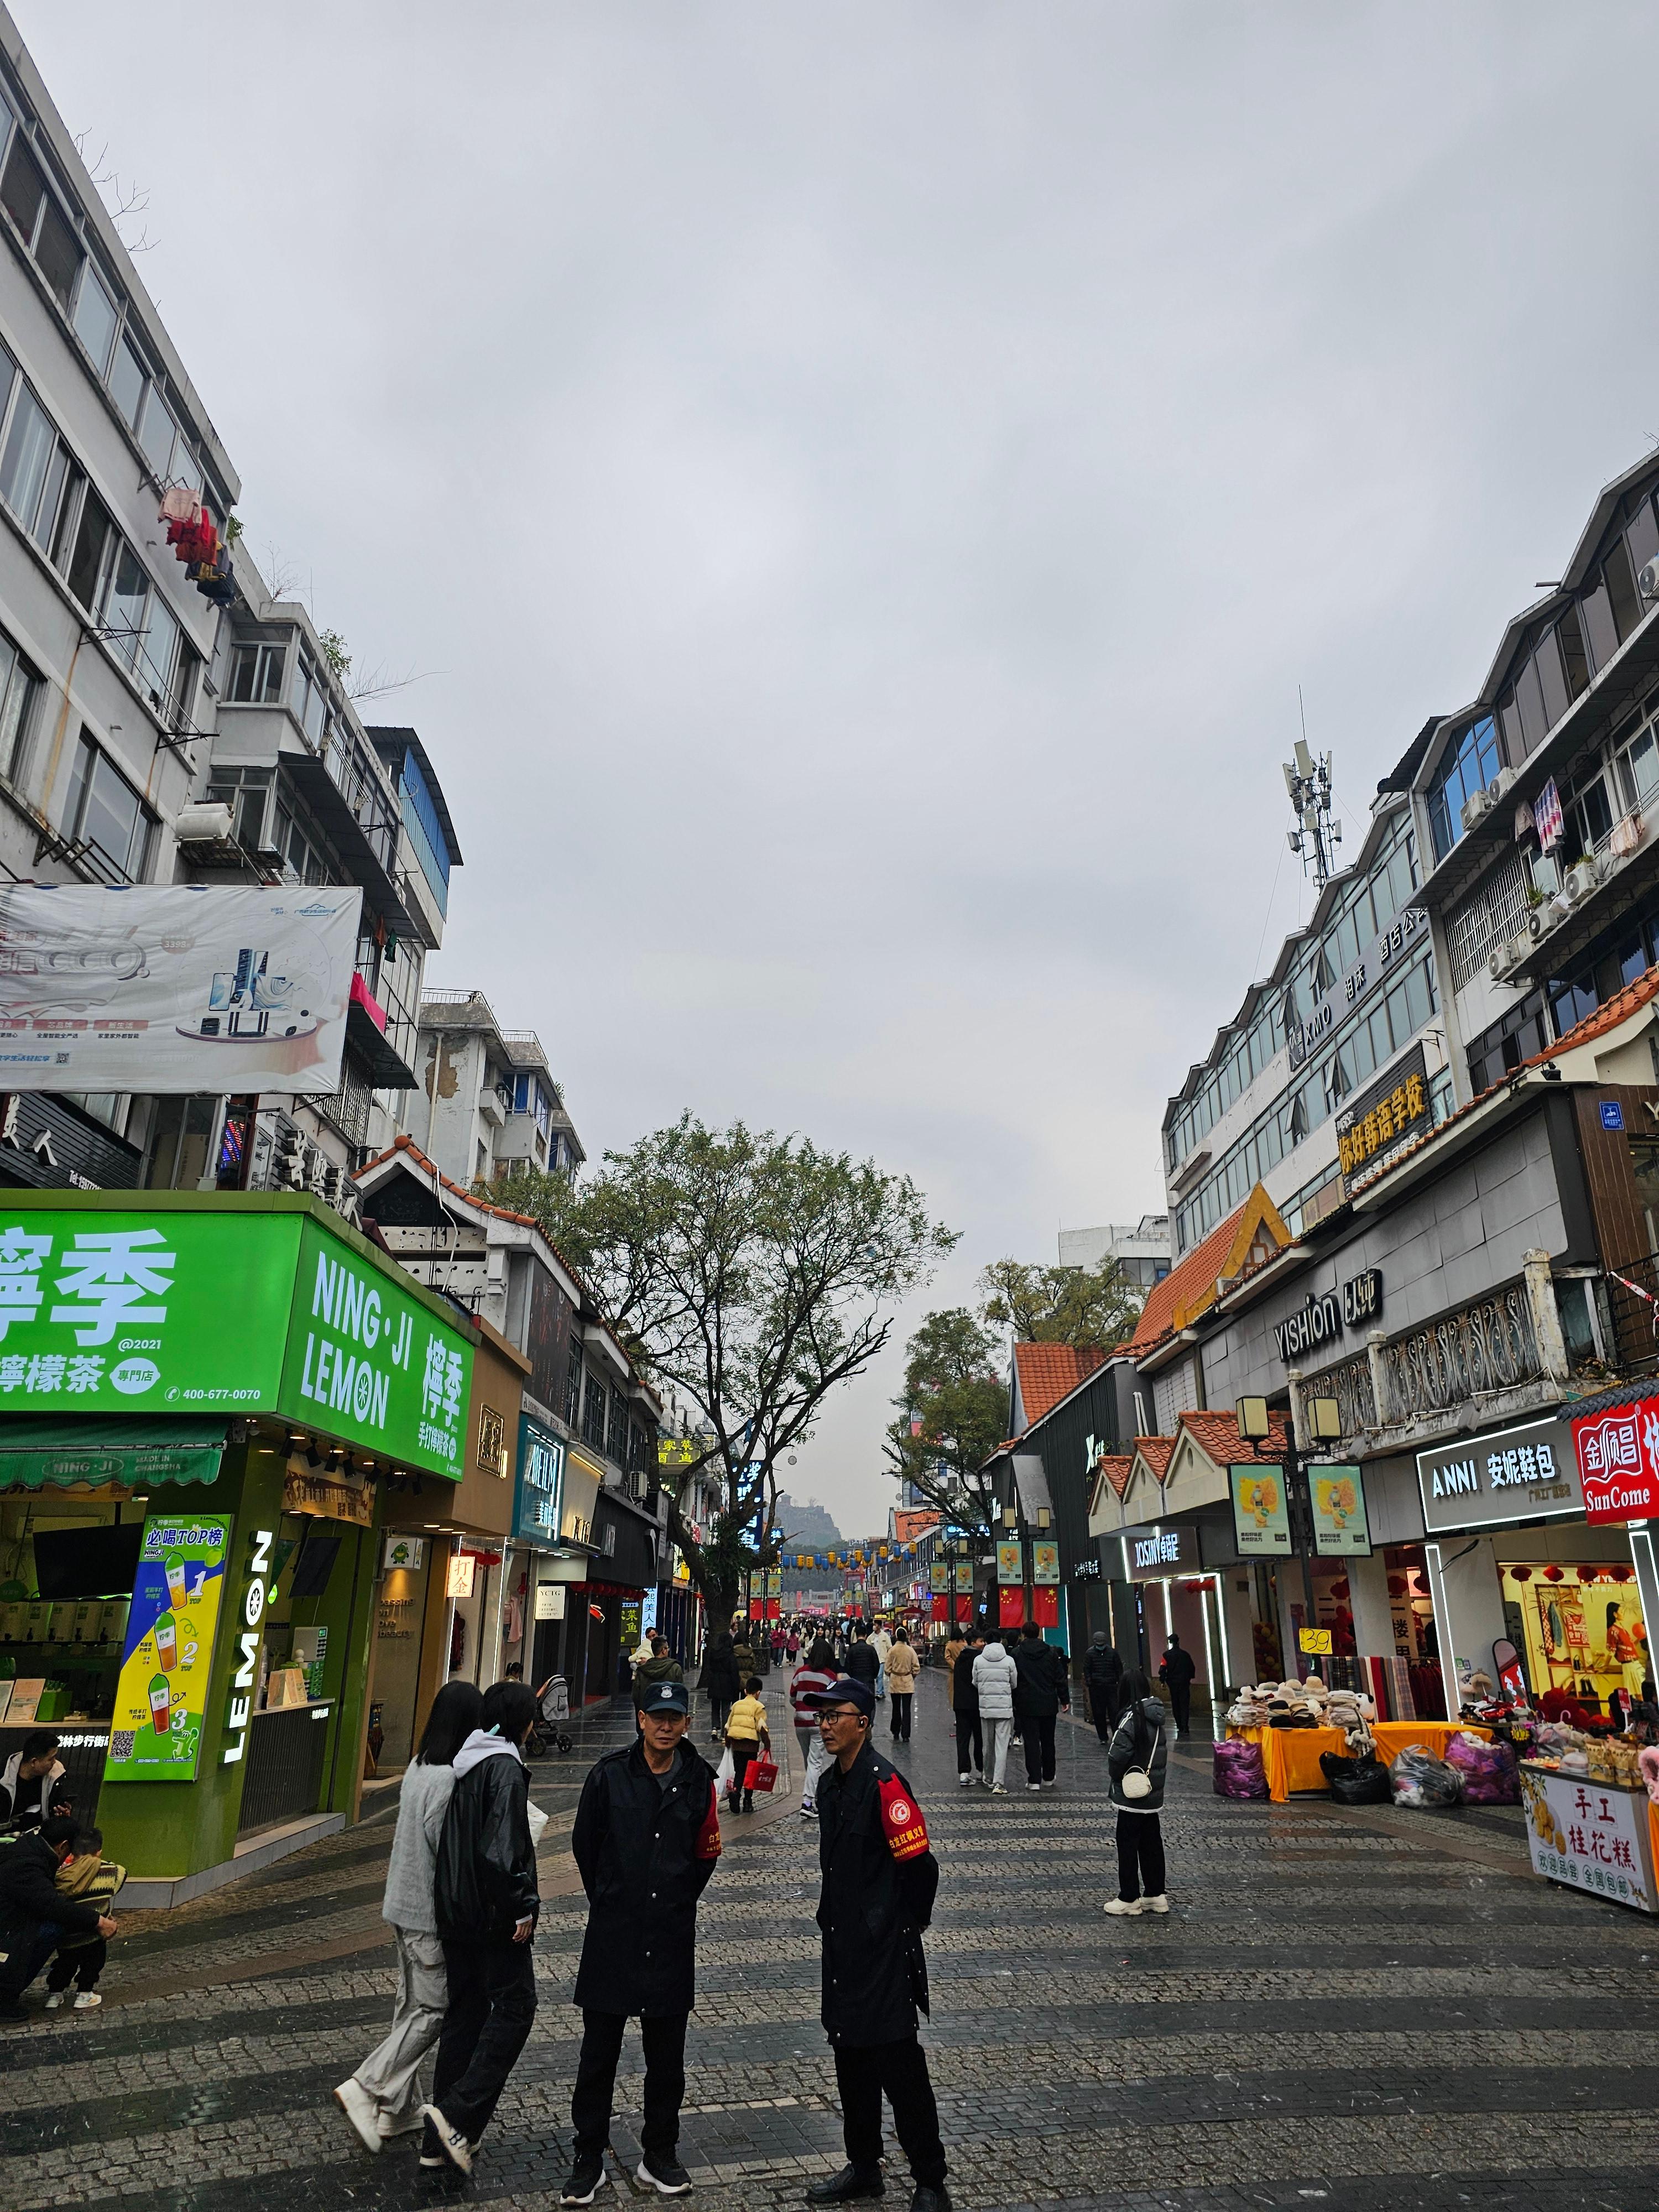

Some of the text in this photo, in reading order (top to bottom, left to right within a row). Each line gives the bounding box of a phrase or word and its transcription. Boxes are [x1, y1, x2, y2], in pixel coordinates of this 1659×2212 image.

[1306, 1004, 1330, 1045] XMO
[1339, 1073, 1425, 1176] 你好韩语学校
[118, 1338, 161, 1352] @2021
[118, 1370, 154, 1383] 專門店
[300, 1332, 390, 1430] LEMON
[182, 1389, 261, 1400] 400-677-0070
[657, 1439, 693, 1451] 家菜
[1432, 1459, 1478, 1499] ANNI
[1487, 1443, 1556, 1489] 安妮鞋包
[1586, 1486, 1651, 1512] SunCome
[146, 1528, 223, 1547] 必喝TOP榜
[1135, 1537, 1161, 1568] JOSINY
[189, 1571, 207, 1597] 1
[452, 1559, 471, 1594] 打金
[180, 1641, 199, 1665] 2
[223, 1530, 273, 1764] LEMON
[1305, 1629, 1329, 1651] 39
[171, 1708, 188, 1730] 3
[1575, 1787, 1615, 1823] 手工
[1568, 1824, 1636, 1872] 桂花糕
[1538, 1852, 1628, 1896] 欢迎品尝 全国包邮
